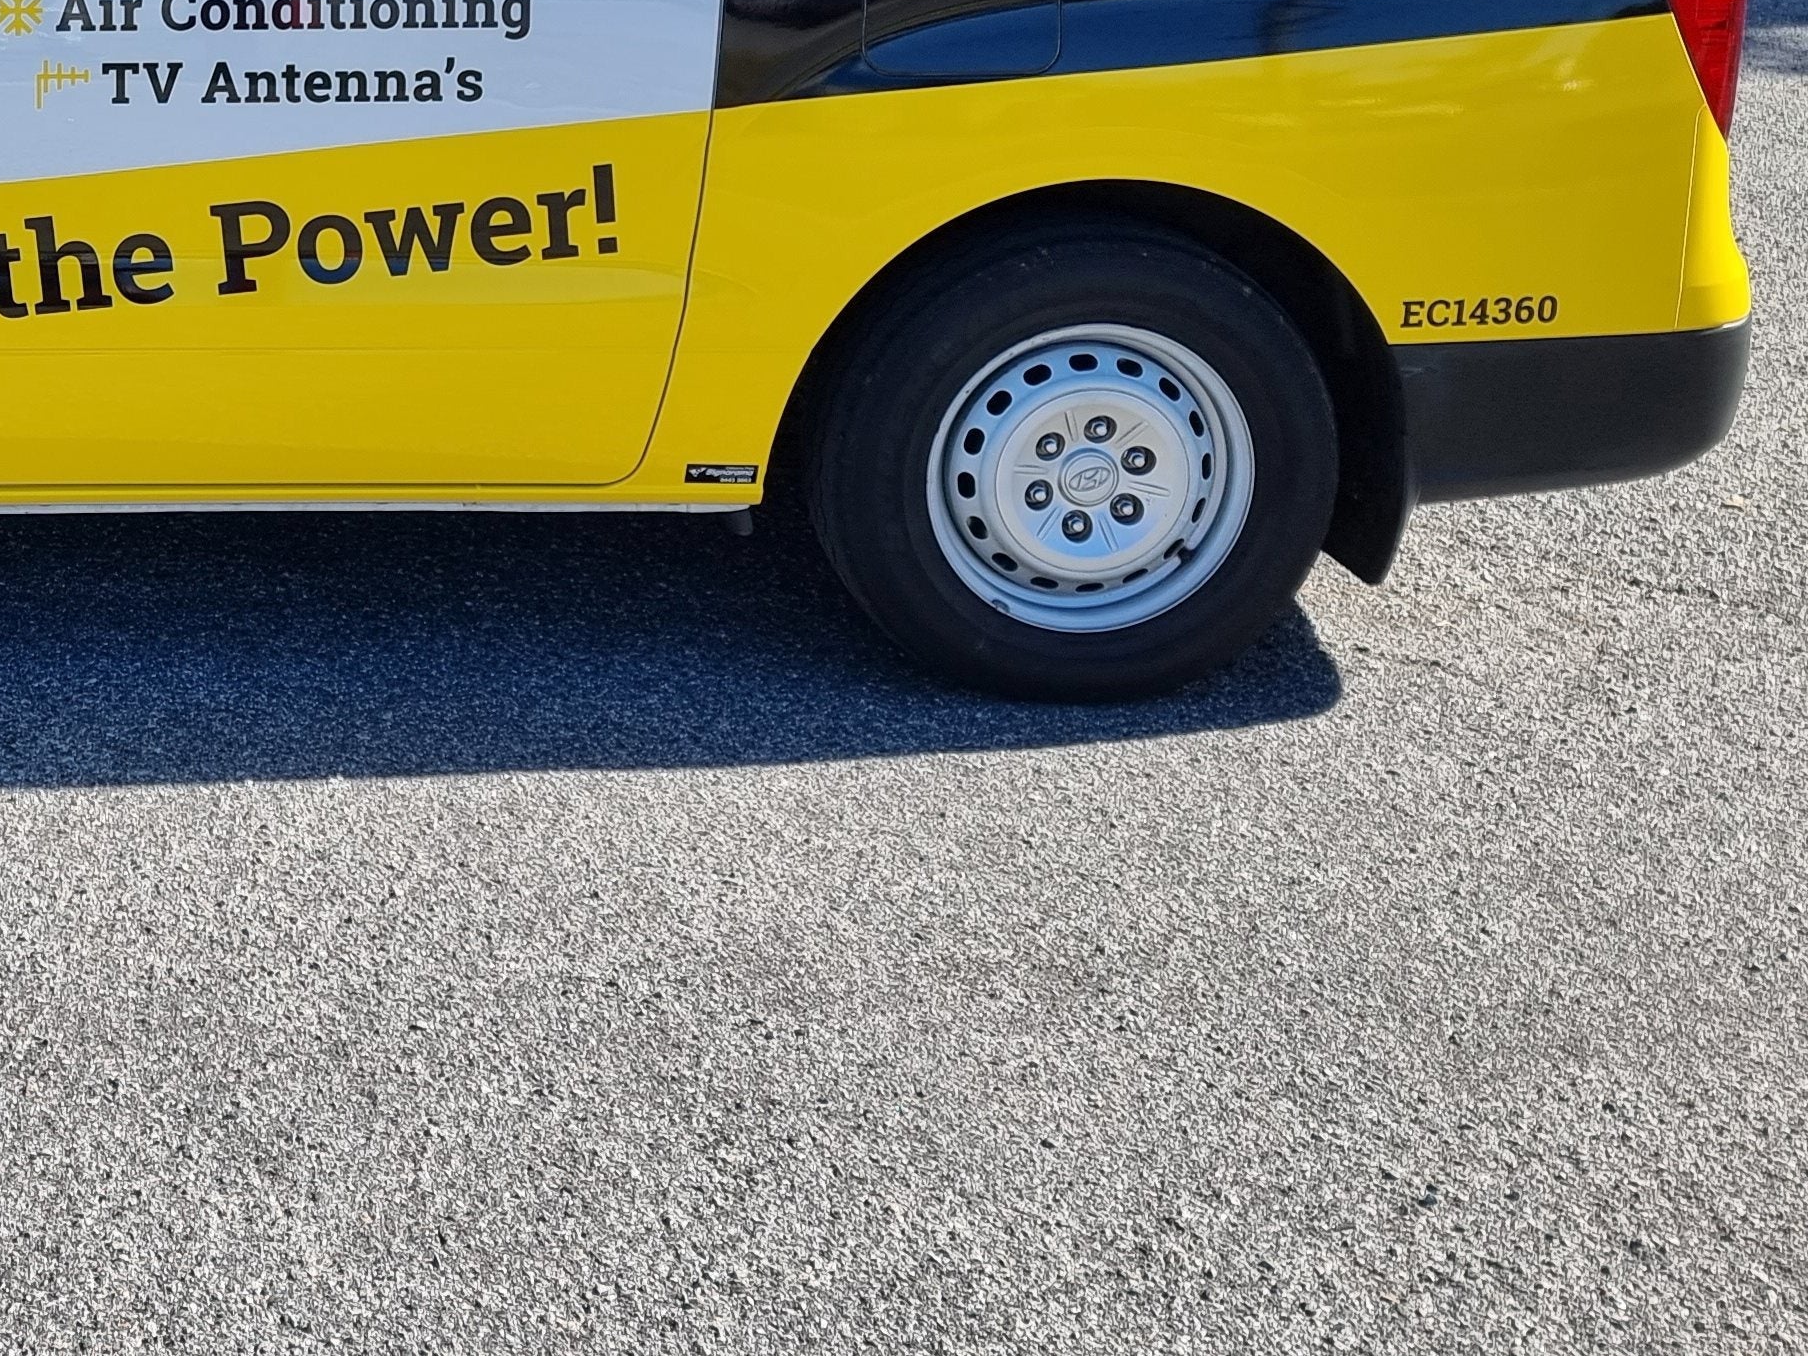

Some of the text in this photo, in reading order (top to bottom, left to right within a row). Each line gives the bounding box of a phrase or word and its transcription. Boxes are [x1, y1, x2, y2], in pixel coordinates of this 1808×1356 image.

[101, 61, 184, 105] TV
[210, 163, 620, 294] Power!
[1399, 295, 1559, 329] EC14360
